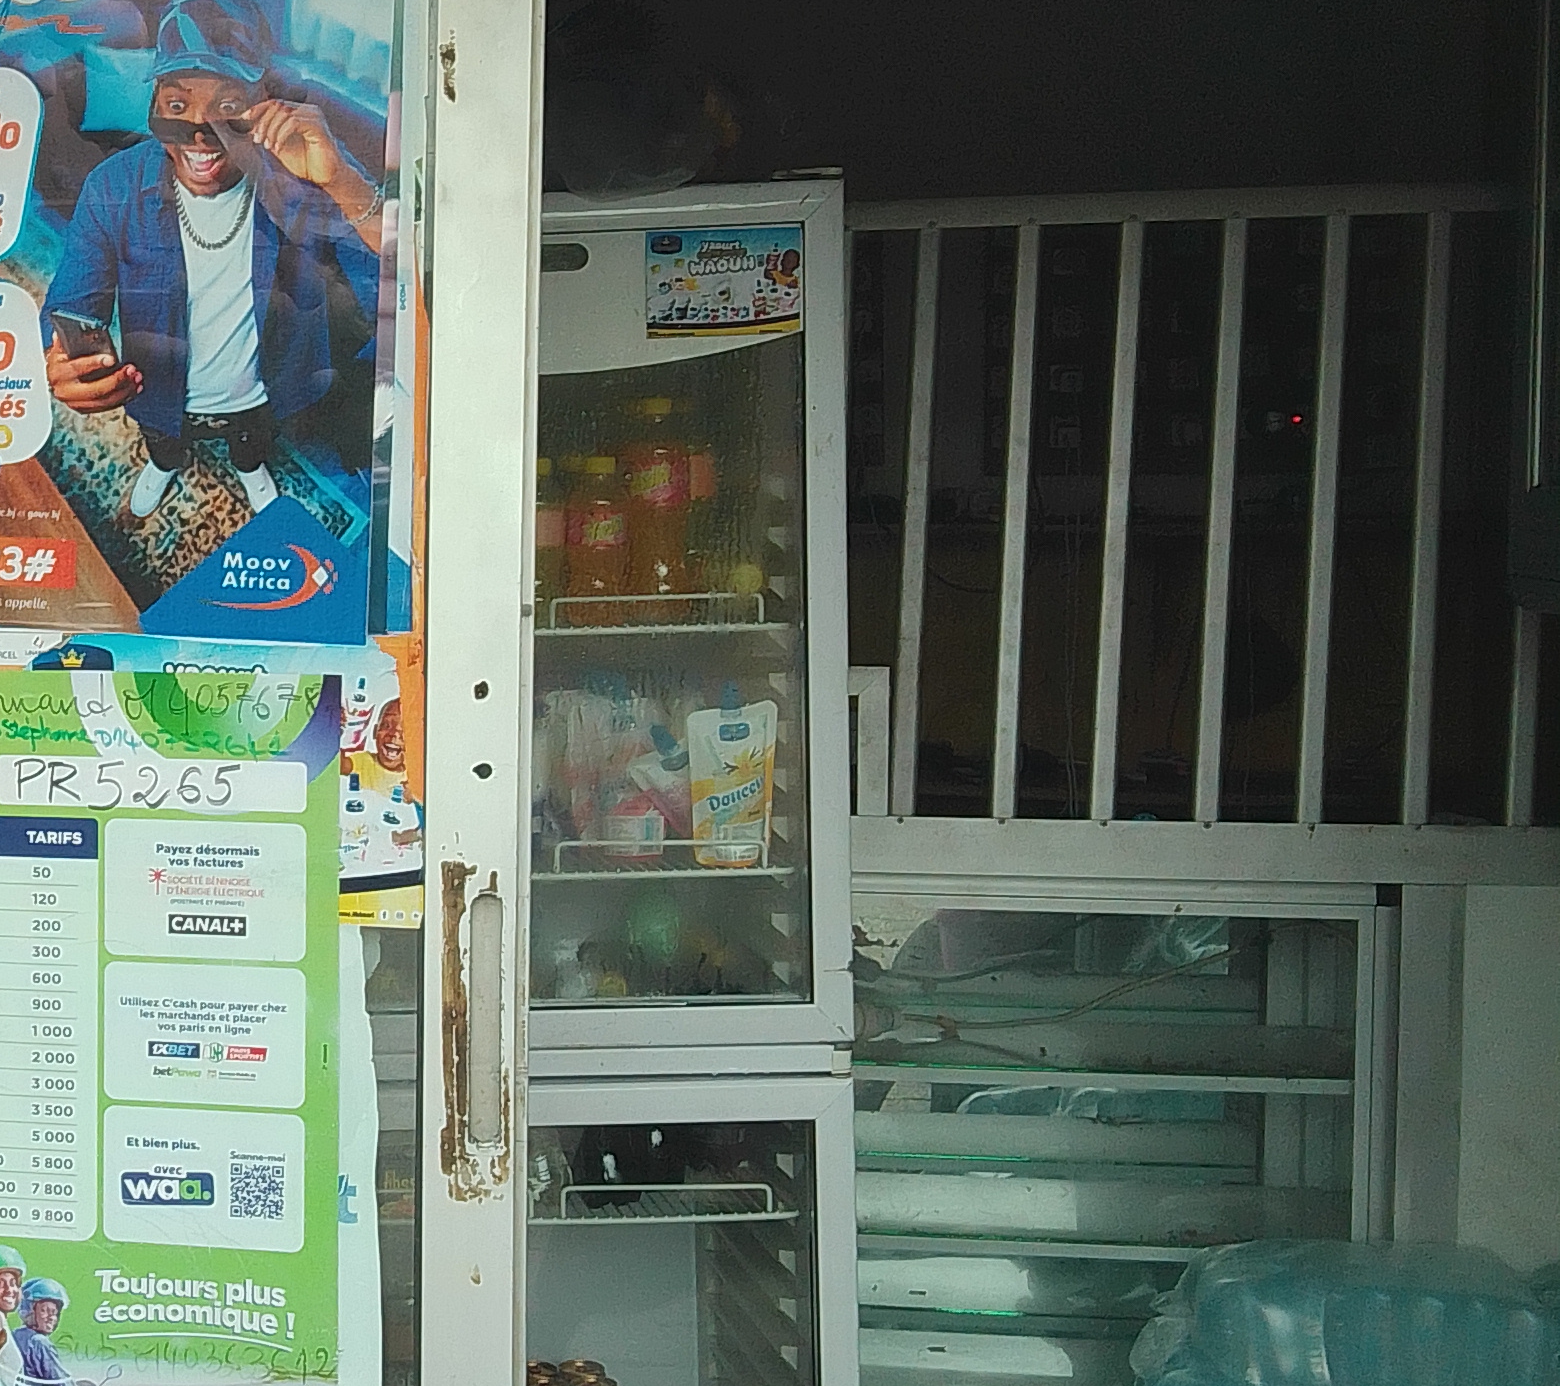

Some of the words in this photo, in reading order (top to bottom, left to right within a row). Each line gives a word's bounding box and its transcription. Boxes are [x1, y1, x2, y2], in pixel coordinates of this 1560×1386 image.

[223, 551, 291, 571] Moov
[223, 570, 291, 592] Africa
[26, 830, 82, 845] TARIFS
[156, 844, 192, 856] Payez
[196, 844, 260, 857] désormais
[168, 858, 189, 866] vos
[194, 857, 244, 868] factures
[32, 867, 51, 879] 50
[32, 893, 57, 905] 120
[32, 919, 61, 932] 200
[171, 916, 244, 933] CANAL+
[32, 946, 61, 958] 300
[32, 972, 61, 984] 600
[32, 999, 61, 1011] 900
[120, 997, 159, 1007] Utilisez
[200, 1001, 225, 1011] pour
[228, 1002, 259, 1013] payer
[261, 1002, 287, 1012] chez
[140, 1009, 155, 1018] les
[158, 1011, 216, 1021] marchands
[219, 1014, 229, 1022] et
[233, 1012, 267, 1024] placer
[158, 1023, 176, 1031] vos
[179, 1022, 205, 1034] paris
[208, 1025, 221, 1033] en
[225, 1024, 251, 1035] ligne
[152, 1043, 196, 1056] 1XBET
[127, 1137, 139, 1147] Et
[143, 1137, 168, 1149] bien
[154, 1165, 183, 1175] avec
[94, 1269, 218, 1299] Toujours
[225, 1279, 286, 1307] plus
[94, 1301, 278, 1335] économique
